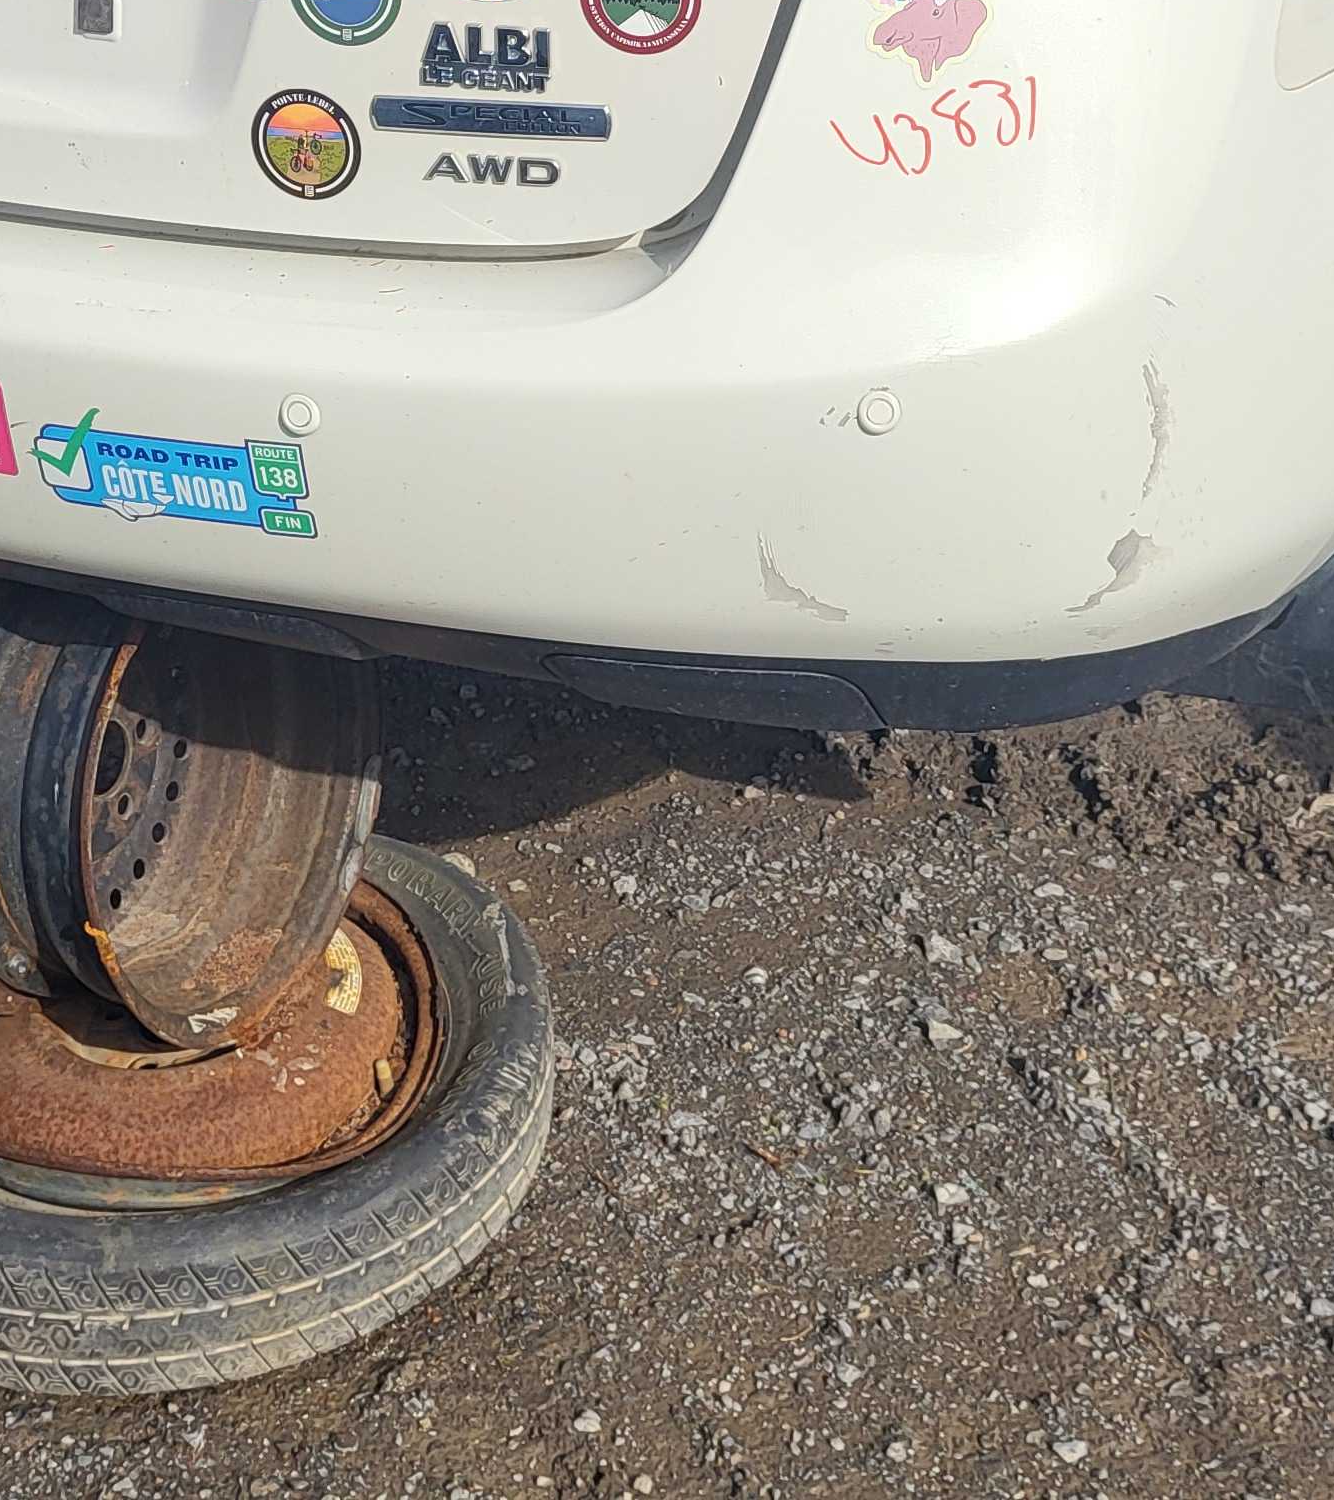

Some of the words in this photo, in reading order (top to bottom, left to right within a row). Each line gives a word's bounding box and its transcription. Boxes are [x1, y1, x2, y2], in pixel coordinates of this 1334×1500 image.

[420, 20, 552, 69] ALBI
[419, 64, 454, 88] LE
[457, 64, 552, 95] GÉANT
[400, 101, 582, 127] SPECIAL
[502, 121, 582, 136] EDITION
[829, 75, 1037, 176] 43831
[421, 151, 562, 188] AWD
[97, 442, 171, 465] ROAD
[175, 451, 239, 472] TRIP
[254, 445, 297, 462] ROUTE
[101, 460, 167, 506] CÔTE
[170, 472, 249, 513] NORD
[257, 464, 298, 491] 138
[274, 514, 303, 532] FIN
